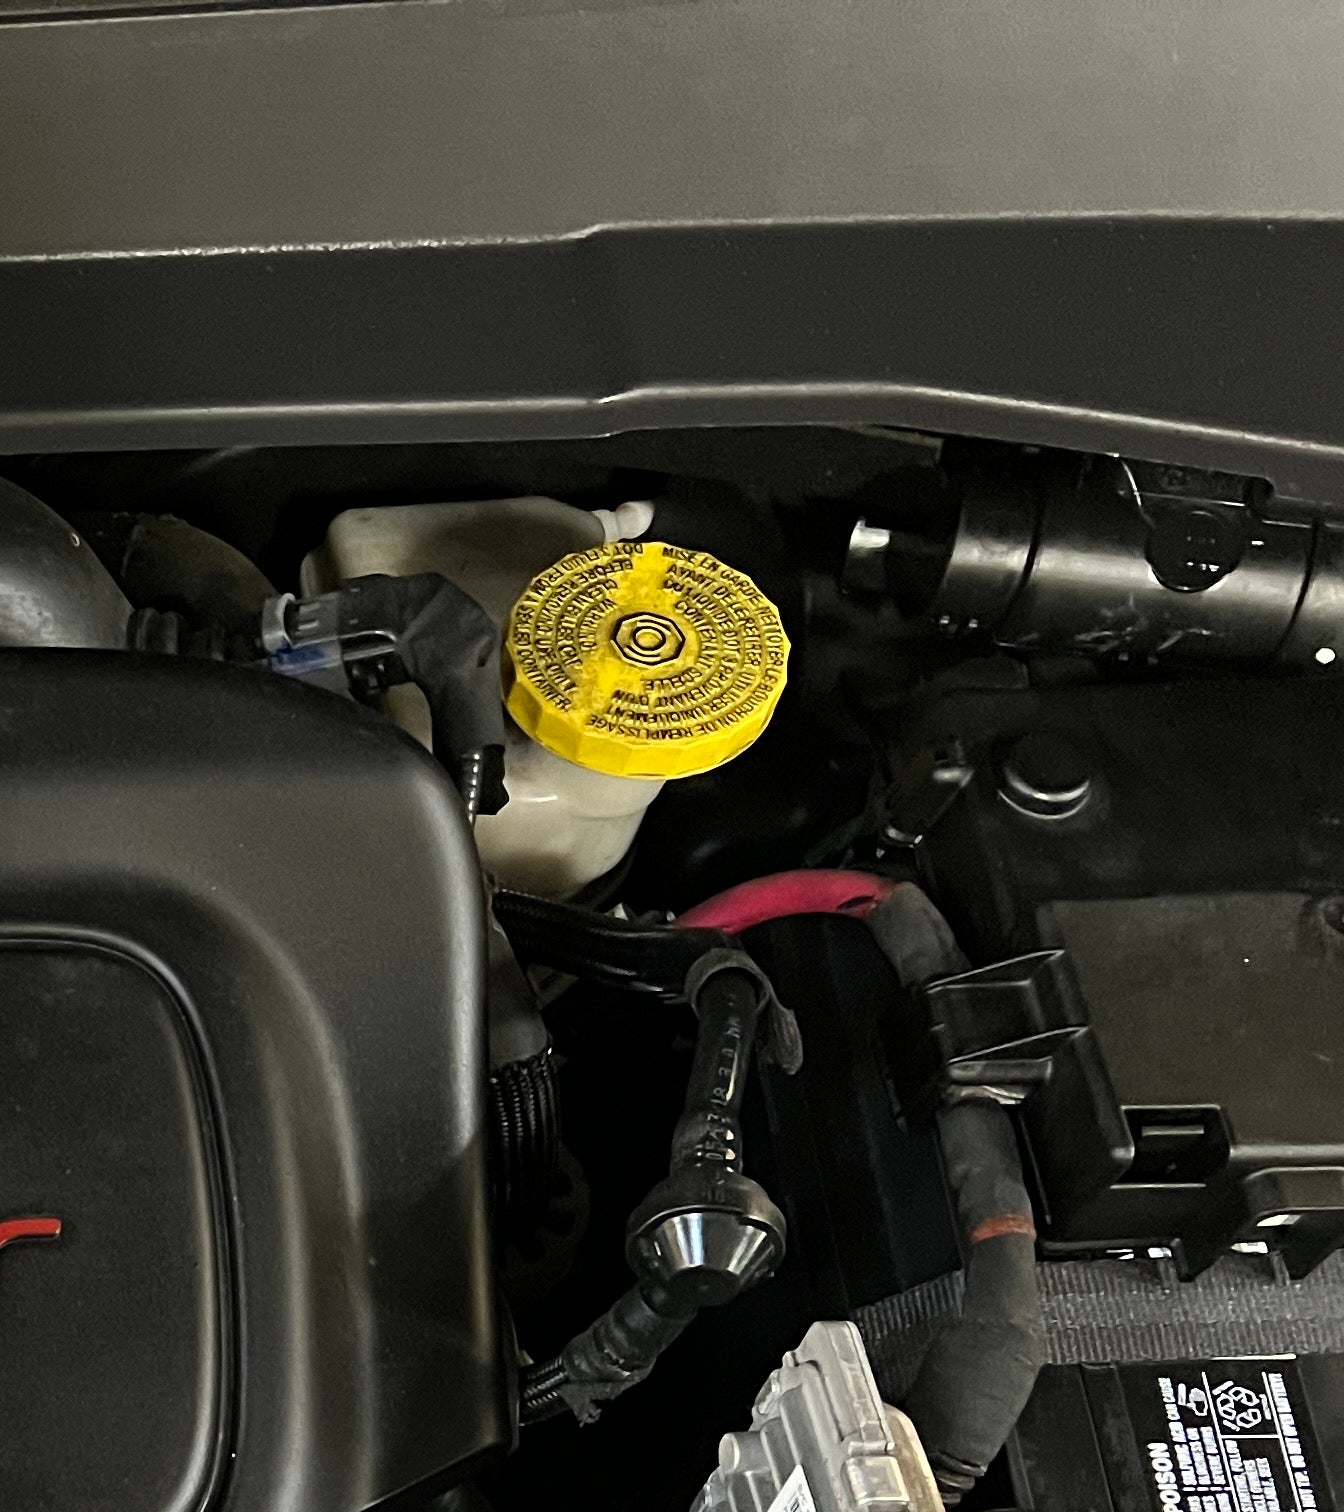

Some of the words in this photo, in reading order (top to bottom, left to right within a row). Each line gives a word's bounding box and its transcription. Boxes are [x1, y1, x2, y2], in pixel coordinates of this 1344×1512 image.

[613, 542, 643, 556] DOT
[571, 556, 633, 586] BEFORE
[665, 563, 718, 587] AVANT
[711, 584, 738, 604] DE
[718, 566, 765, 603] GARDE
